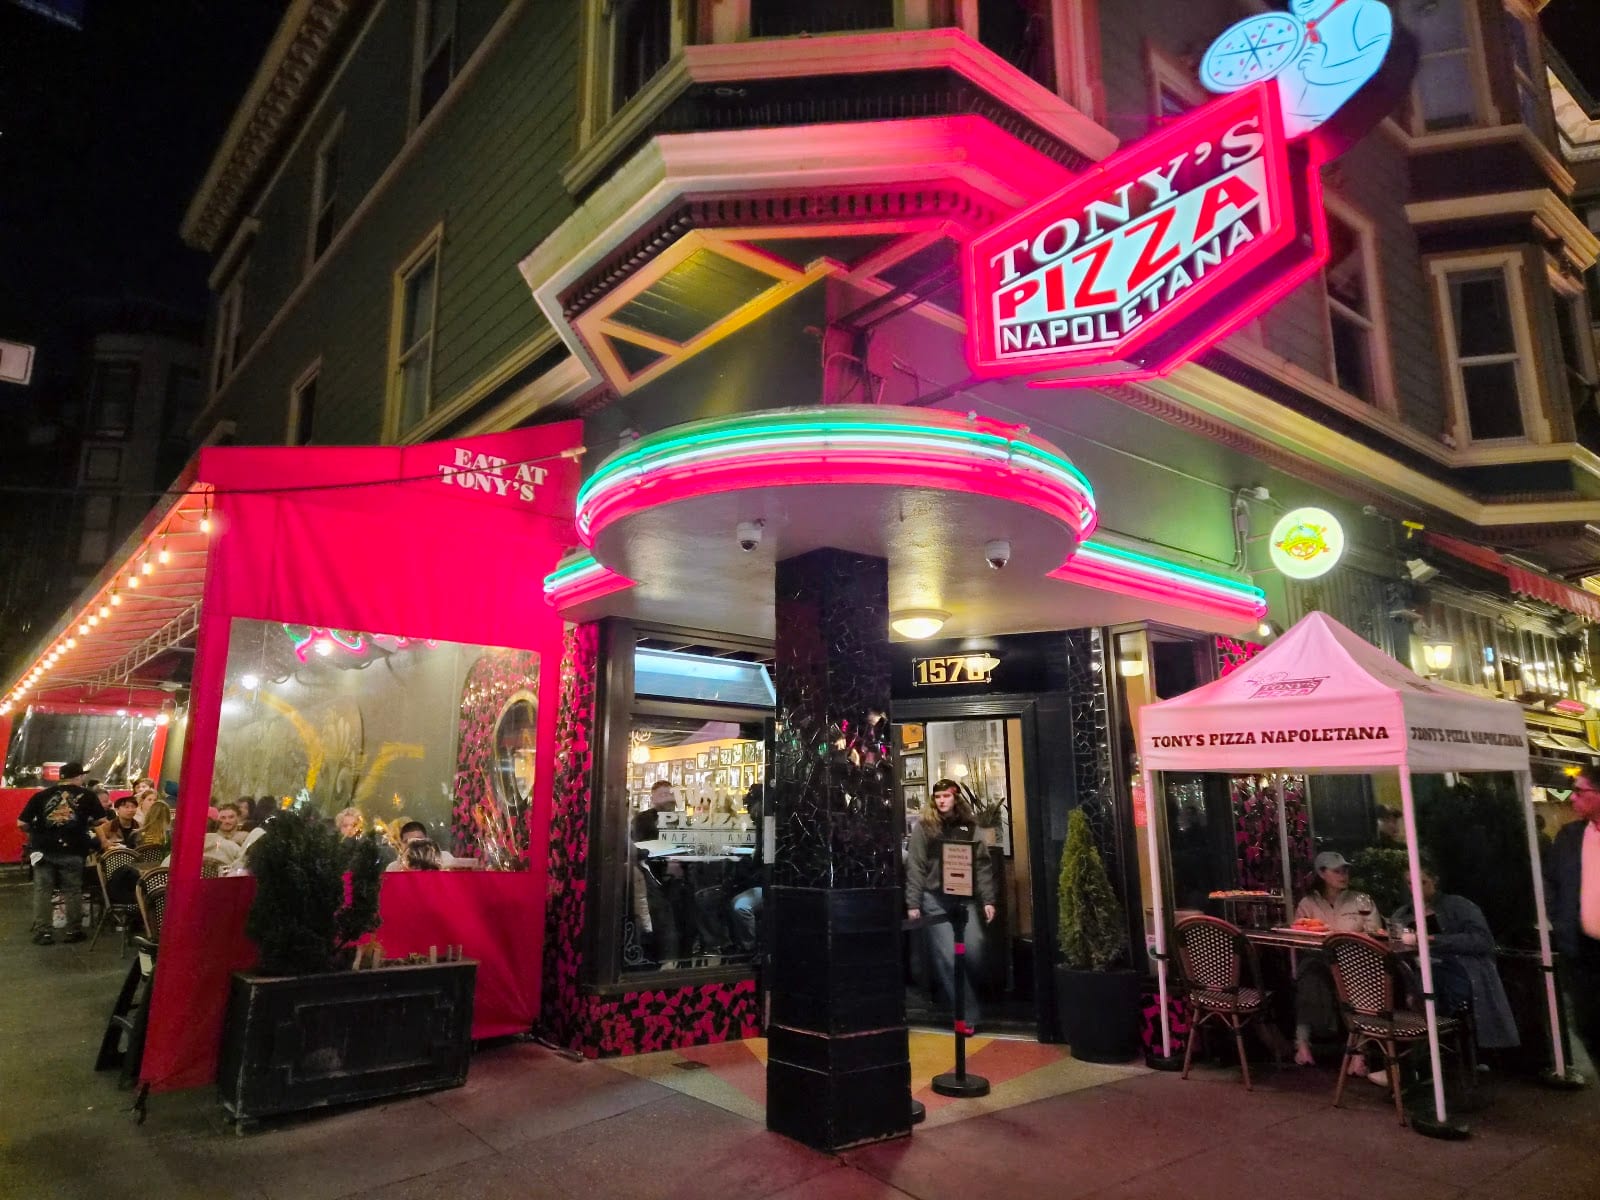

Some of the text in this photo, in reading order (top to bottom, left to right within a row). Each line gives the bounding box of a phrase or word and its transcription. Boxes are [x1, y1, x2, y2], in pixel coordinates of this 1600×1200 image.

[990, 115, 1264, 285] TONY'S
[1000, 175, 1259, 319] PIZZA
[1003, 219, 1254, 351] NAPOLETANA
[438, 464, 535, 502] TONY'S
[453, 447, 548, 485] EAT AT
[1151, 726, 1390, 748] TONY'S PIZZA NAPOLETANA
